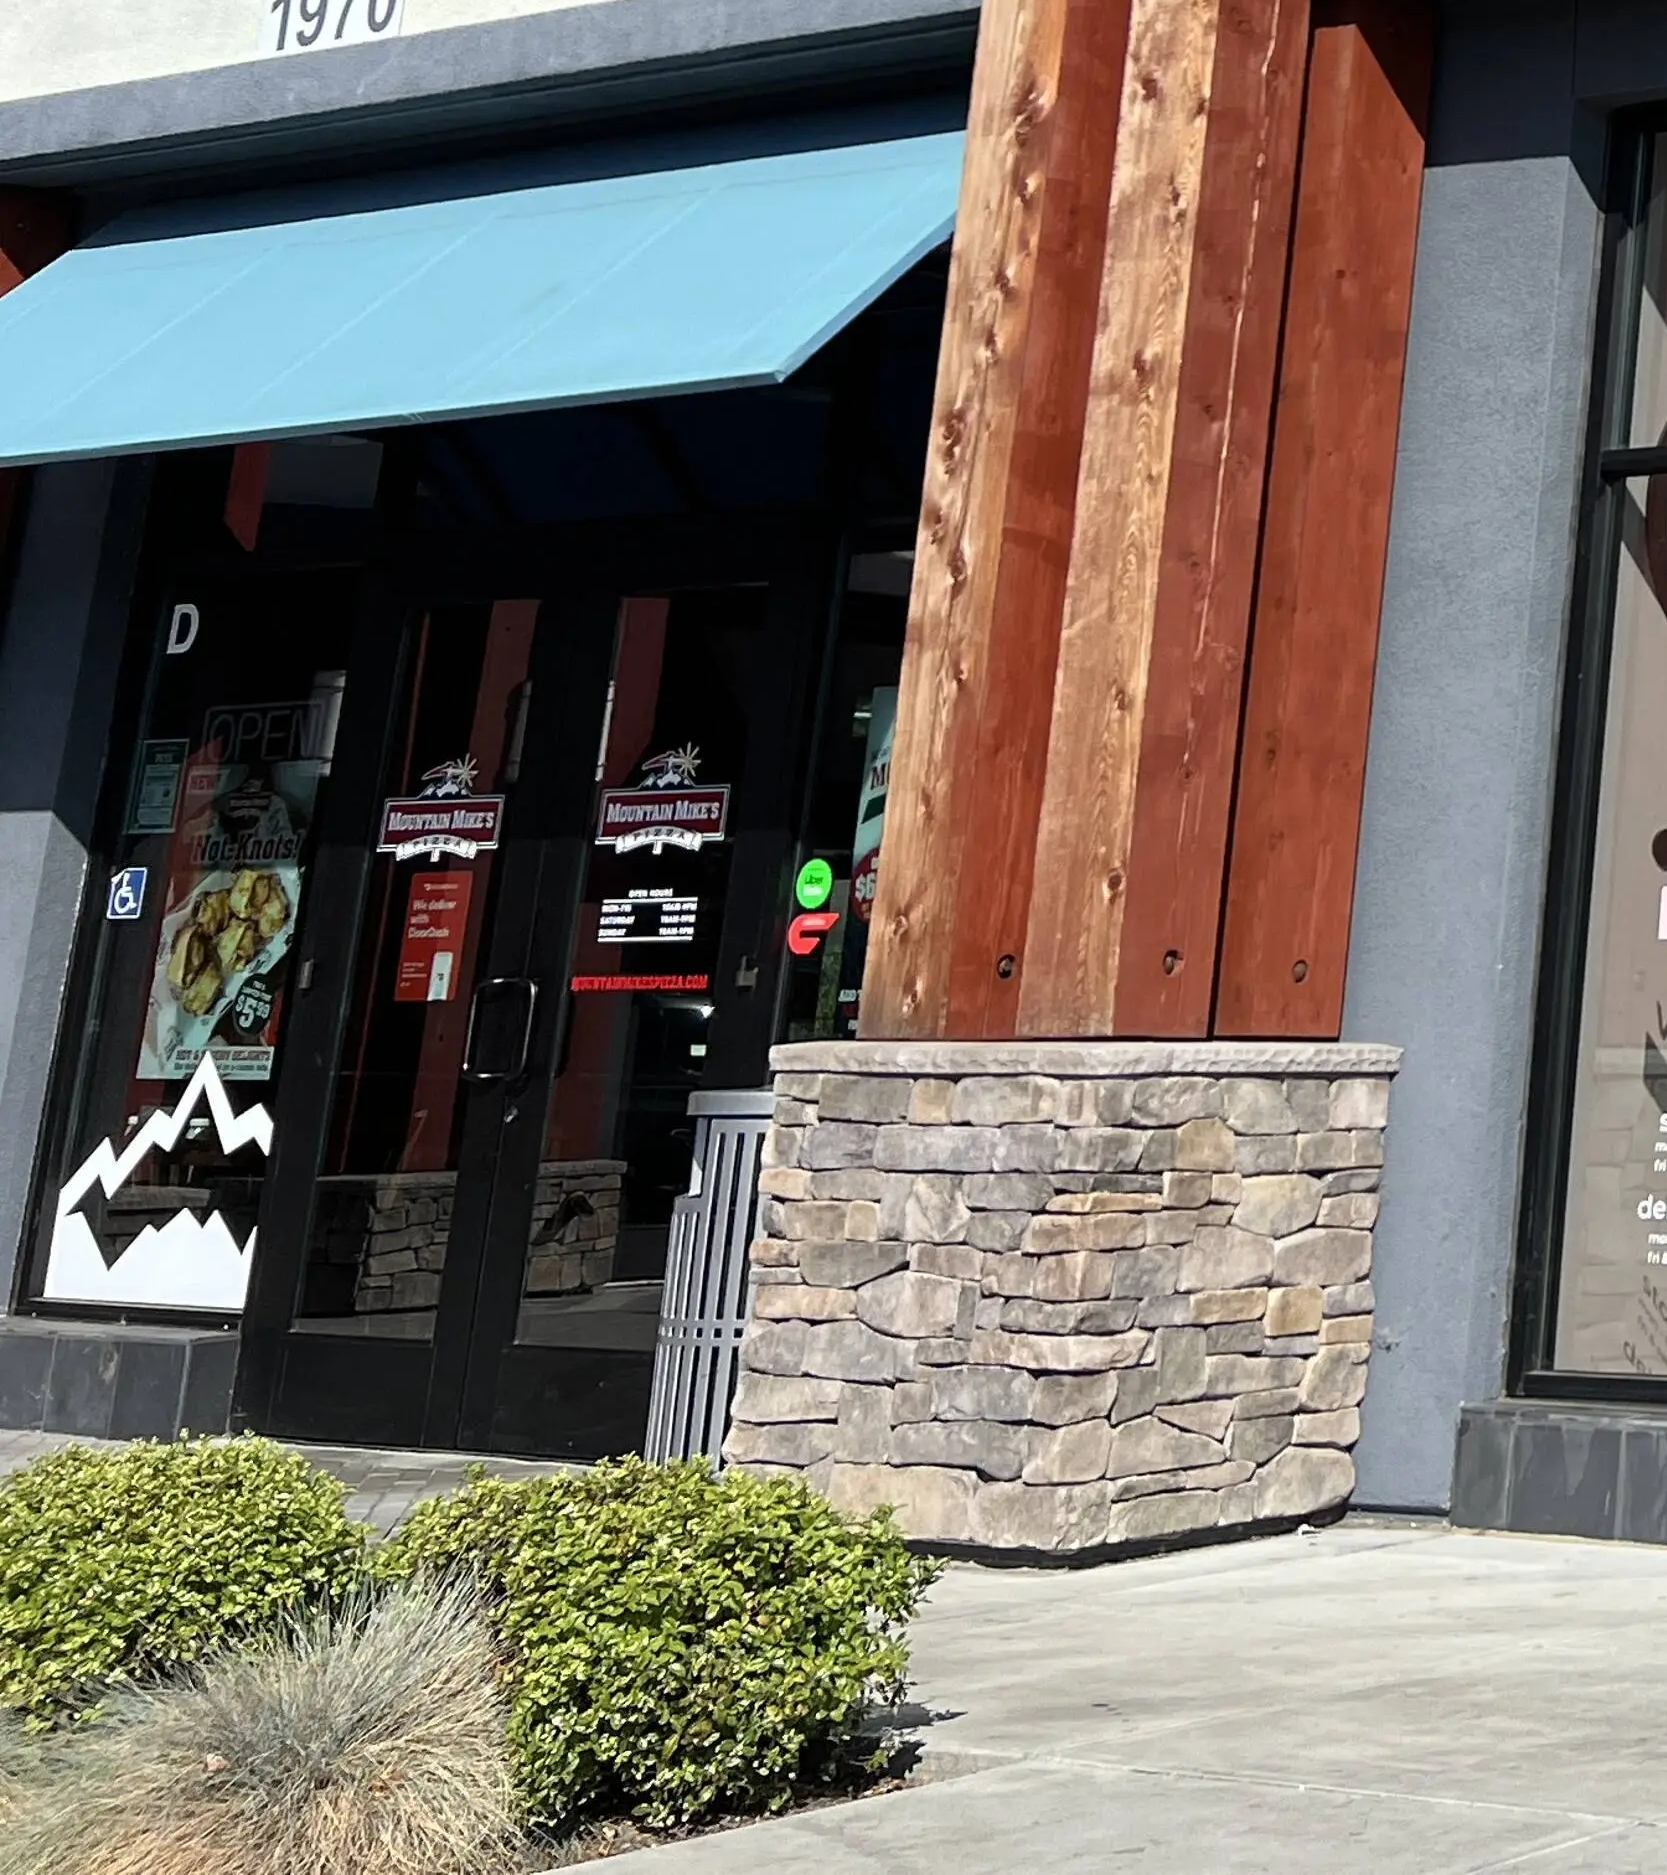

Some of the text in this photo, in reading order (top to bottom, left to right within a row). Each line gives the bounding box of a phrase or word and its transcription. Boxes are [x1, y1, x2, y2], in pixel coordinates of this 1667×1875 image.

[166, 603, 200, 654] D
[388, 812, 450, 831] MOUNTAIN
[606, 800, 720, 823] MOUNTAIN MIKE'S
